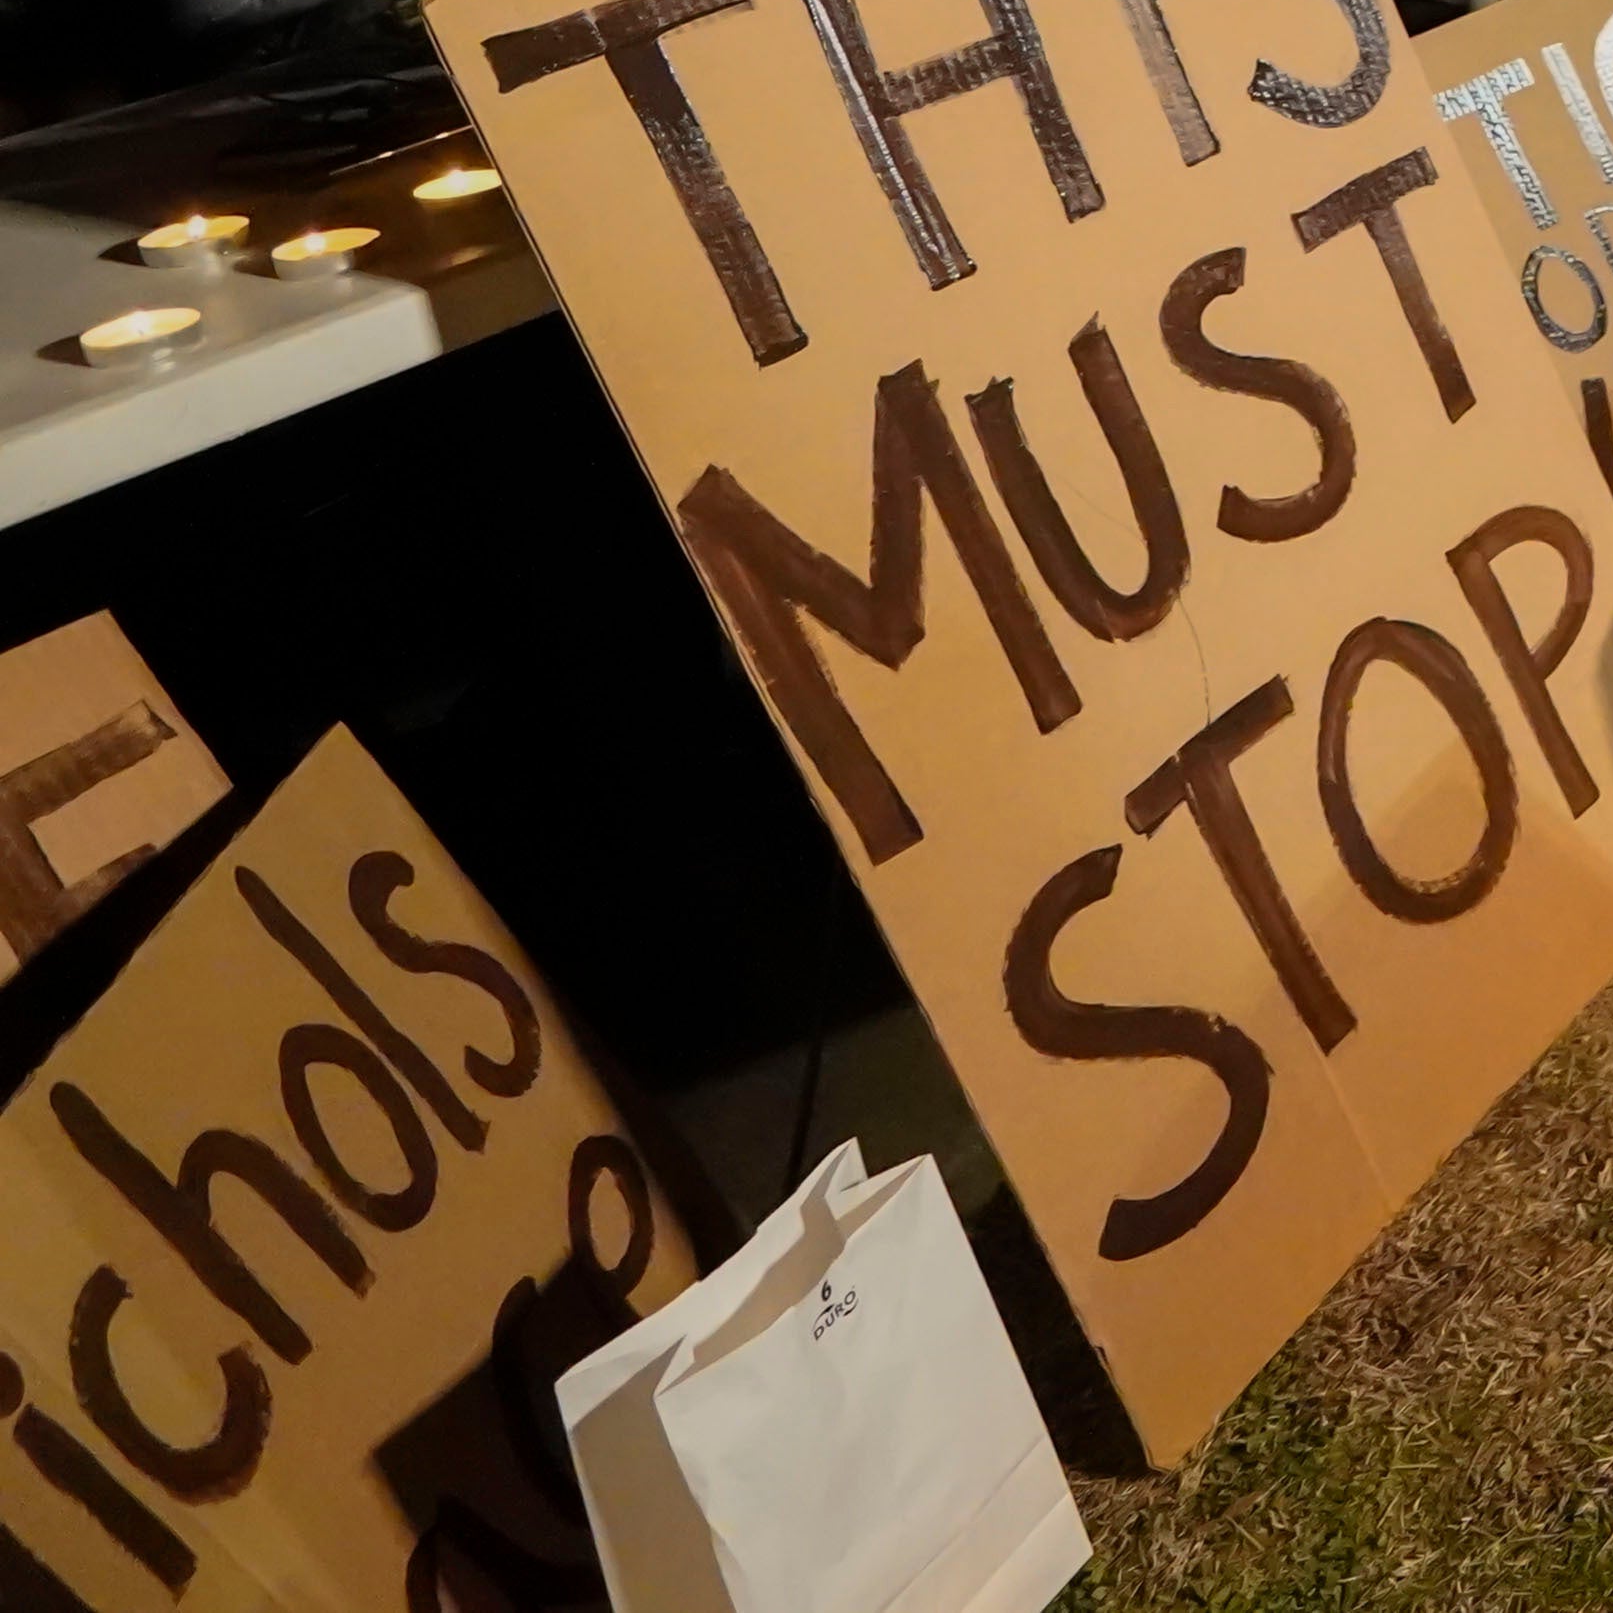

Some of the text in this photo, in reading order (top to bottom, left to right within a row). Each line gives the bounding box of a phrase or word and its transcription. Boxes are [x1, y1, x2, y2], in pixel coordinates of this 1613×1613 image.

[677, 146, 1439, 867] MUST
[0, 850, 541, 1613] ichols
[1004, 504, 1599, 1261] STOP
[813, 1290, 856, 1341] DURO
[821, 1279, 832, 1302] 6
